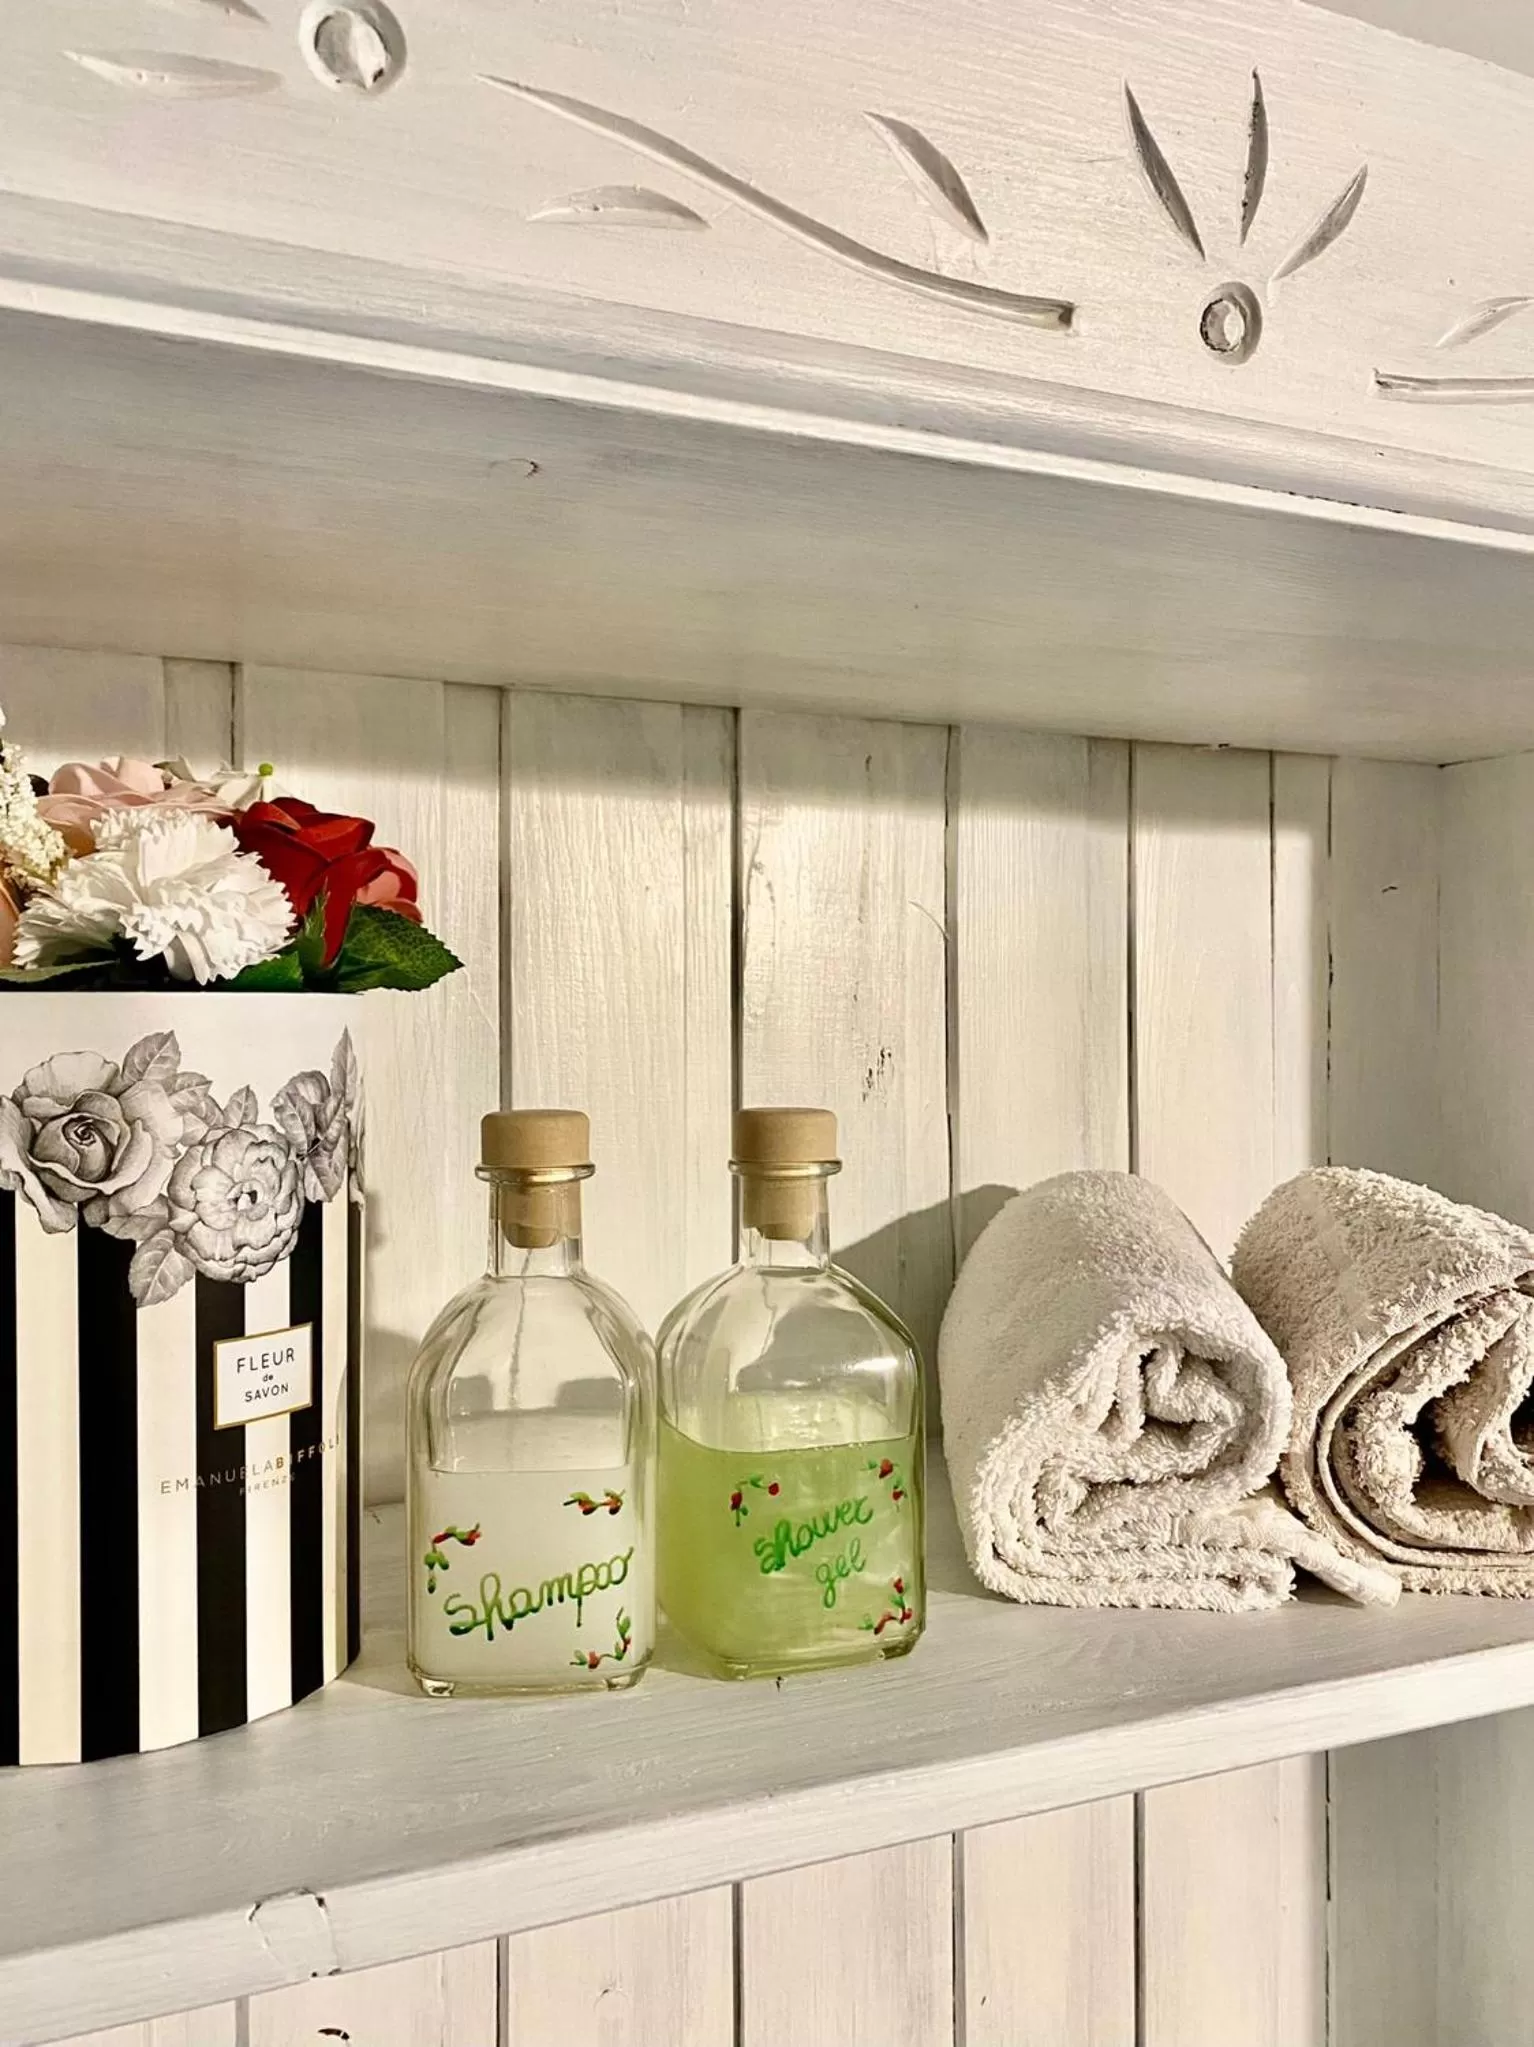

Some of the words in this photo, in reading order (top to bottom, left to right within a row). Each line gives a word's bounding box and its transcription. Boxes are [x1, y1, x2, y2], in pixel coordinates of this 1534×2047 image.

[236, 1347, 296, 1374] FLEUR
[262, 1374, 274, 1383] de
[244, 1383, 290, 1403] SAVON
[815, 1537, 866, 1609] gel
